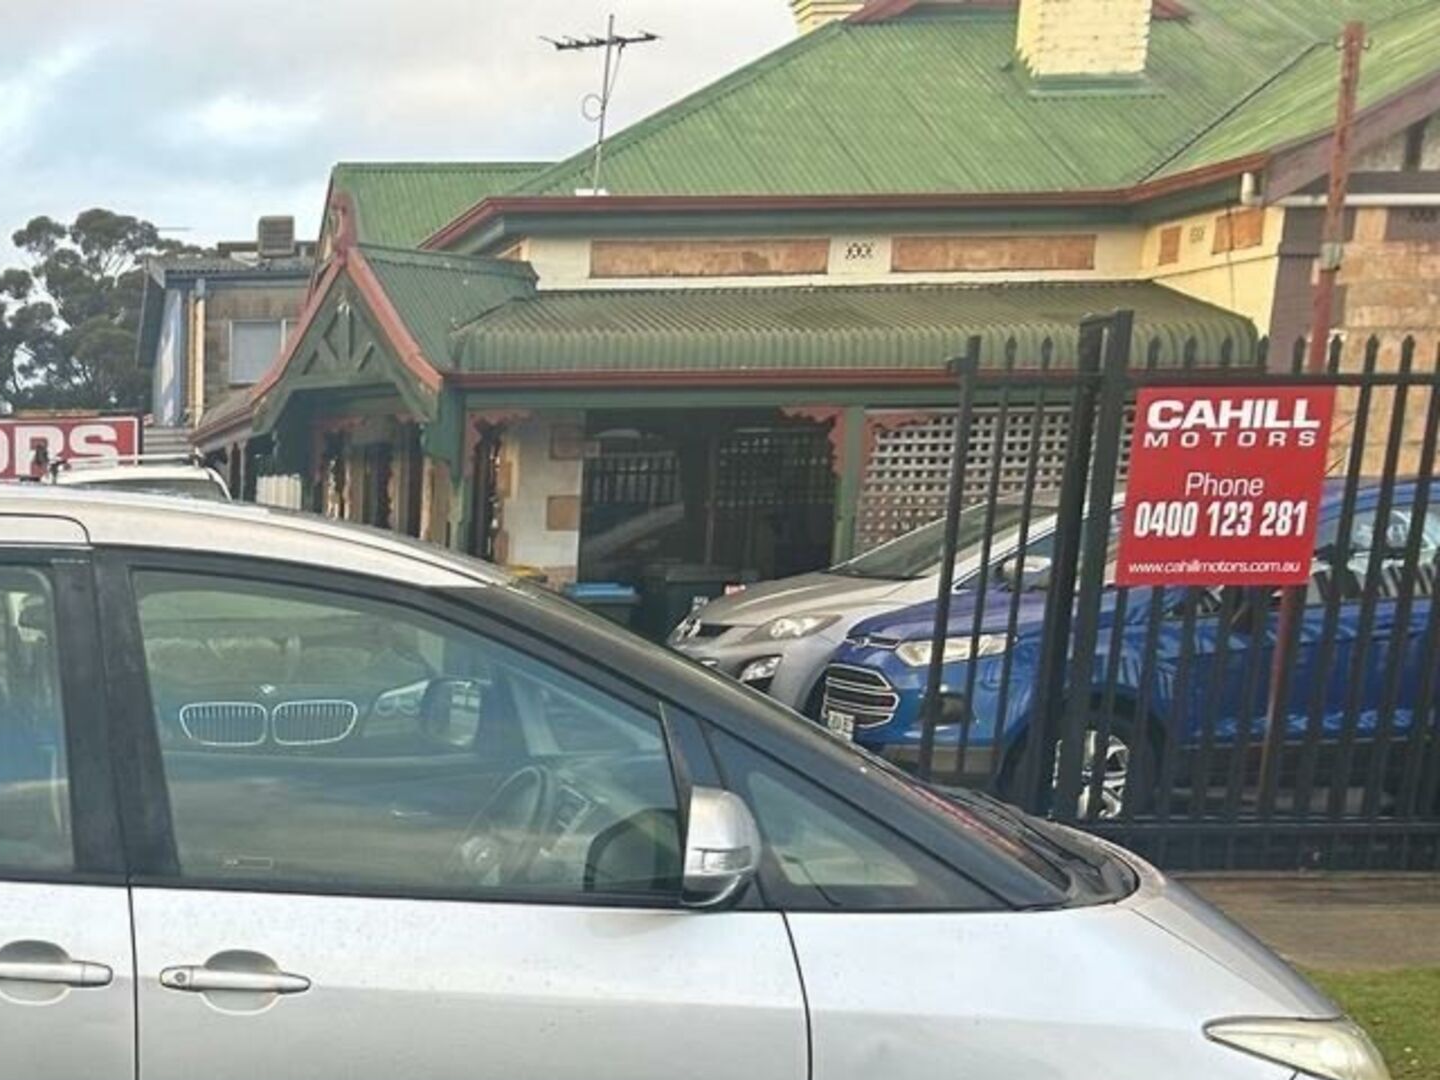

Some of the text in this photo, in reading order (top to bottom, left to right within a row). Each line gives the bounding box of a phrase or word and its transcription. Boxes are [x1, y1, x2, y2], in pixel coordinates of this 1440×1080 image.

[1146, 398, 1321, 430] CAHILL
[1143, 431, 1317, 448] MOTORS
[1185, 472, 1264, 496] Phone
[1133, 500, 1308, 537] 0400 123 281
[1128, 558, 1301, 574] www.cahillmotors.com.au
